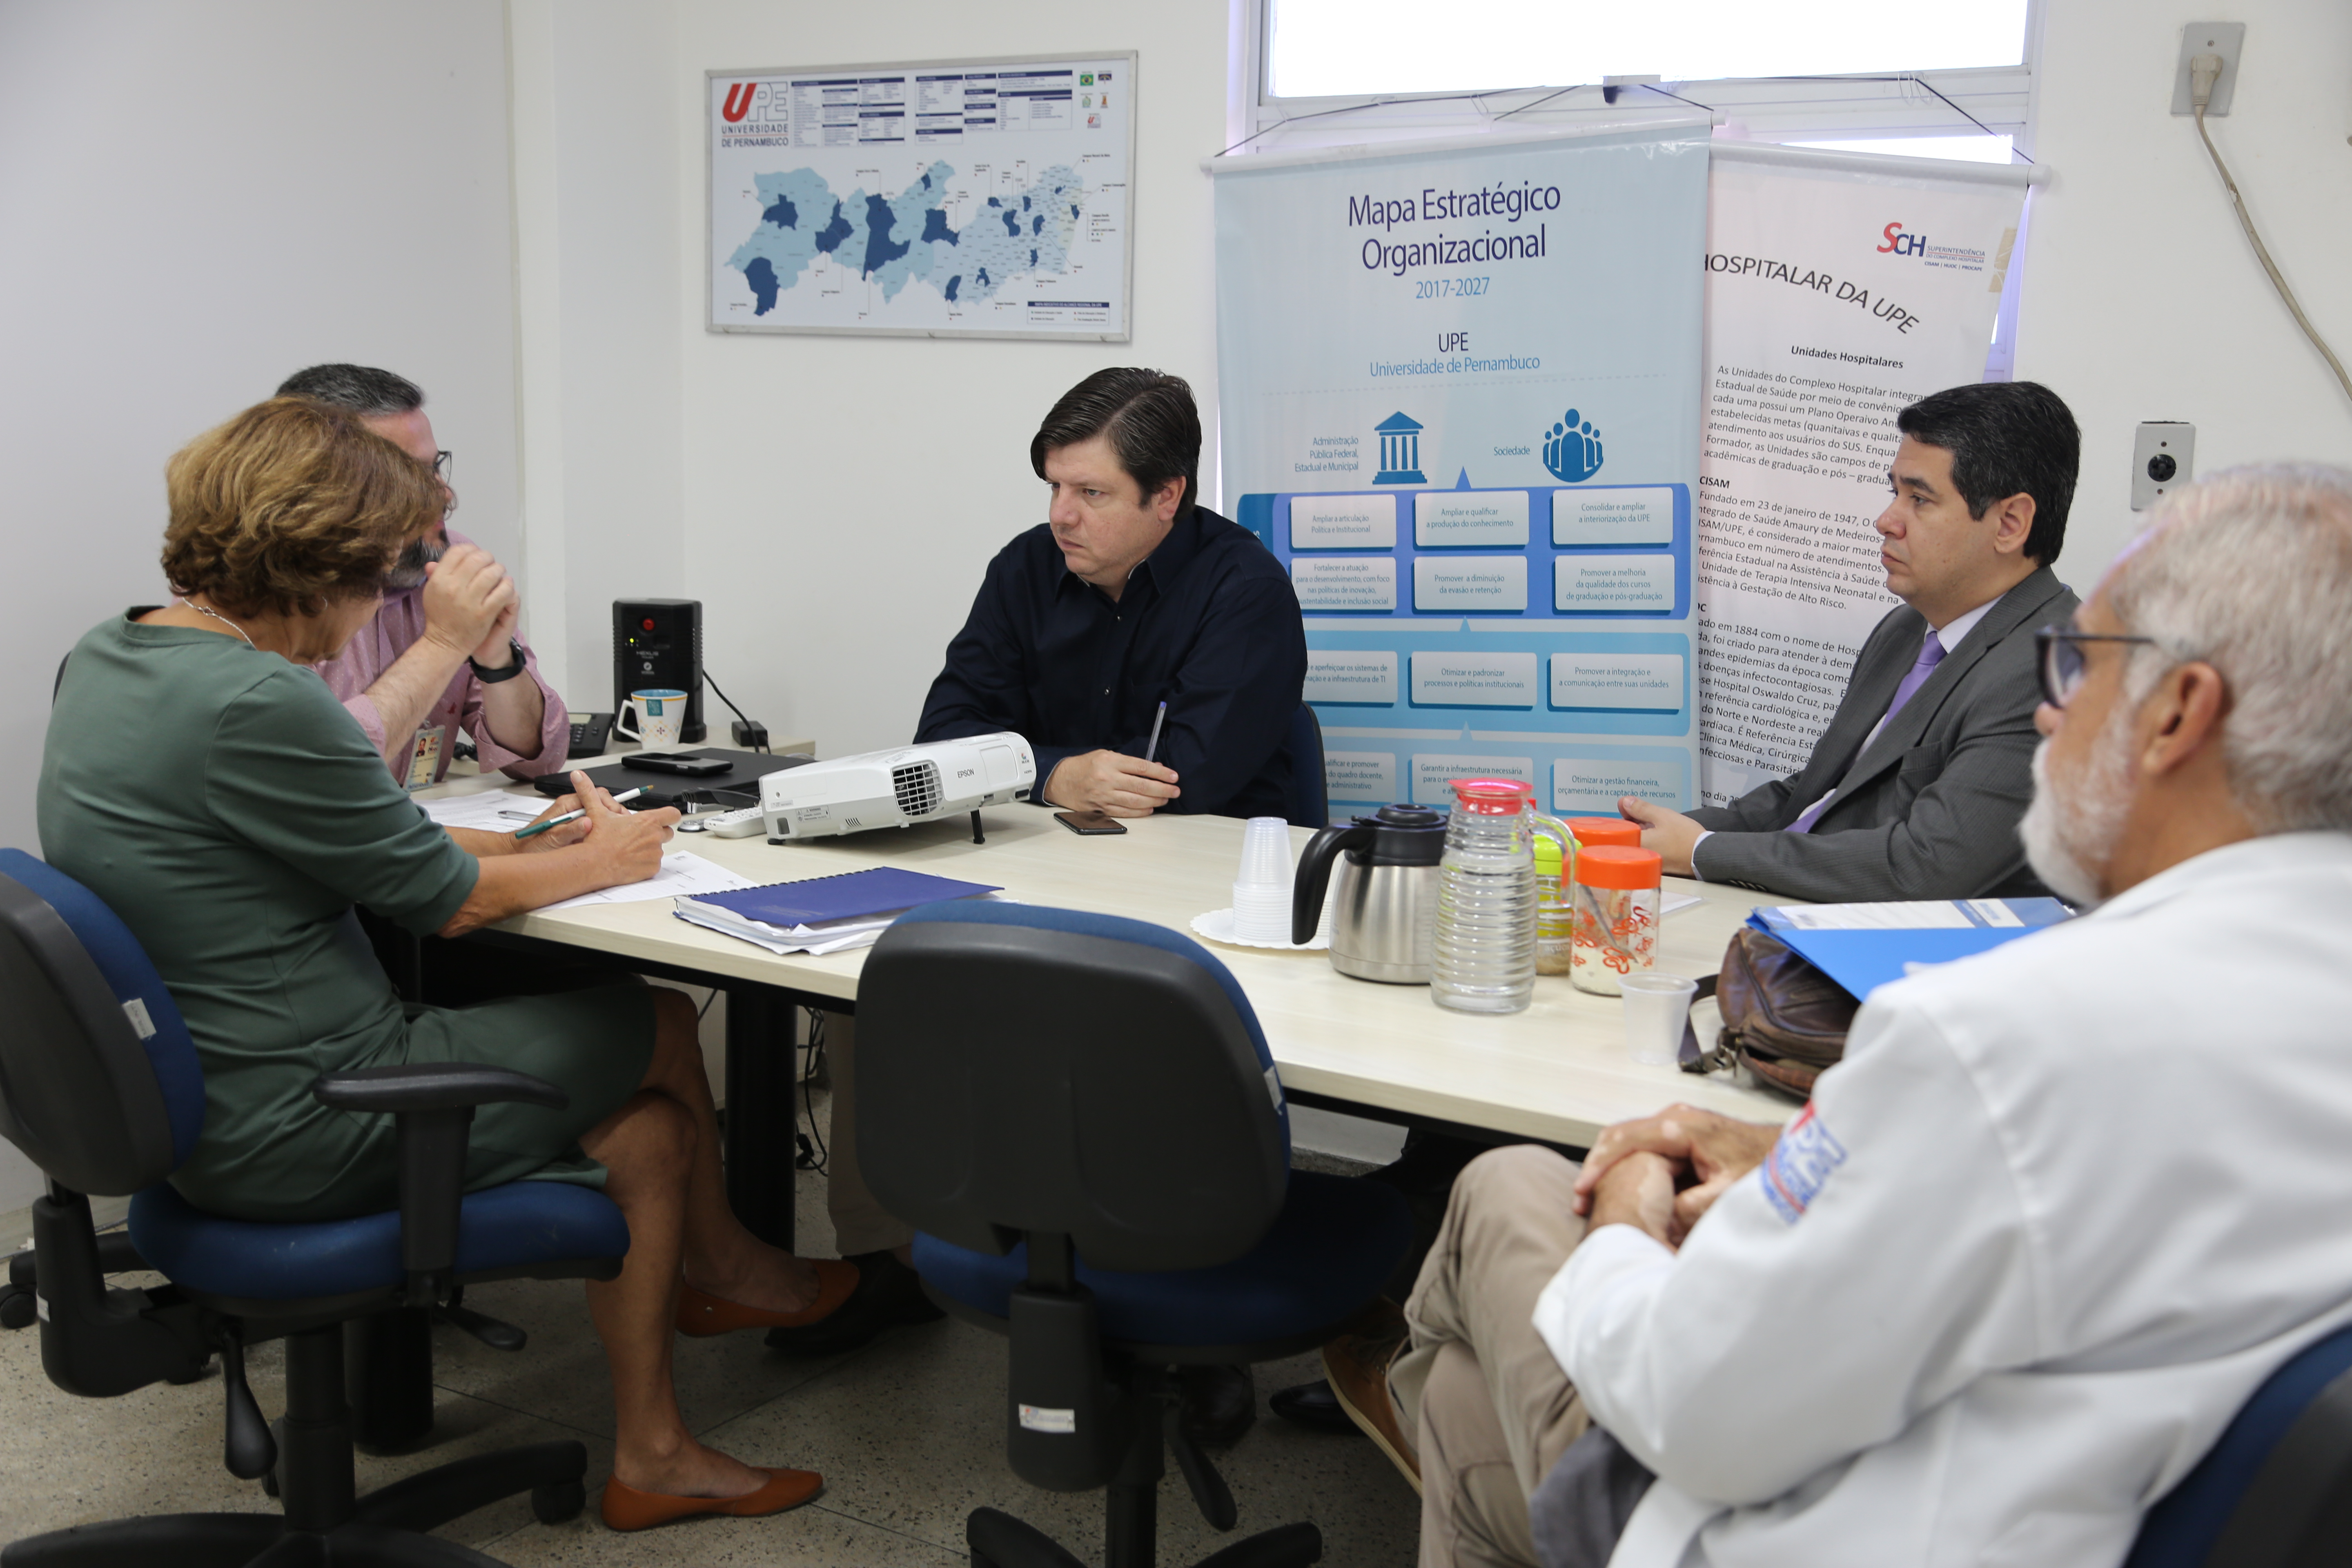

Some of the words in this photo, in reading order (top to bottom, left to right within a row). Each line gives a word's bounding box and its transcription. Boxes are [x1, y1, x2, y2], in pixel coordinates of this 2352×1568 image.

[723, 82, 788, 122] UPE
[722, 124, 788, 134] UNIVERSIDADE
[722, 138, 731, 147] DE
[734, 137, 788, 147] PERNAMBUCO
[1349, 195, 1415, 232] Mapa
[1423, 181, 1560, 222] Estratégico
[1876, 222, 1927, 257] SCH
[1363, 223, 1545, 276] Organizacional
[1927, 246, 1985, 256] SUPERINTENDÊNCIA
[1416, 277, 1490, 299] 2017-2027
[1836, 281, 1868, 309] DA
[1873, 298, 1919, 334] UPE
[1439, 332, 1468, 352] UPE
[1791, 346, 1837, 359] Unidades
[1840, 352, 1903, 368] Hospitalares
[1370, 358, 1444, 376] Universidade
[1447, 357, 1461, 373] de
[1465, 354, 1540, 372] Pernambuco
[1718, 365, 1728, 374] As
[1732, 367, 1772, 381] Unidades
[1775, 374, 1787, 383] do
[1790, 376, 1835, 390] Complexo
[1838, 382, 1887, 396] Hospitalar
[1716, 379, 1755, 392] Estadual
[1757, 385, 1767, 394] de
[1770, 387, 1797, 399] Saúde
[1800, 393, 1816, 402] por
[1819, 396, 1842, 405] meio
[1844, 398, 1855, 407] de
[1713, 394, 1734, 404] cada
[1737, 399, 1757, 407] uma
[1760, 402, 1787, 412] possui
[1790, 406, 1804, 414] um
[1808, 407, 1833, 418] Plano
[1711, 409, 1771, 423] estabelecidas
[1774, 419, 1801, 428] metas
[1313, 436, 1359, 447] Administração
[1310, 450, 1333, 459] Pública
[1334, 448, 1359, 458] Federal,
[1494, 445, 1530, 456] Sociedade
[1295, 462, 1321, 472] Estadual
[1328, 461, 1359, 472] Municipal
[1700, 476, 1729, 488] CISAM
[1441, 508, 1464, 517] Ampliar
[1470, 507, 1498, 517] qualificar
[1581, 503, 1615, 511] Consolidar
[1621, 502, 1645, 512] ampliar
[1699, 491, 1737, 504] Fundado
[1758, 501, 1769, 510] 23
[1771, 503, 1782, 512] de
[1784, 505, 1816, 518] janeiro
[1819, 511, 1831, 520] de
[1834, 513, 1859, 526] 1947,
[1862, 518, 1870, 526] O
[1313, 514, 1333, 523] Ampliar
[1339, 514, 1369, 523] articulação
[1584, 514, 1626, 523] interiorização
[1628, 514, 1636, 522] da
[1336, 525, 1370, 533] Institucional
[1431, 520, 1460, 529] produção
[1618, 568, 1646, 576] melhoria
[1471, 574, 1504, 584] diminuição
[1576, 580, 1584, 588] da
[1585, 579, 1616, 590] qualidade
[1617, 579, 1629, 588] dos
[1702, 561, 1737, 575] Unidade
[1740, 568, 1752, 577] de
[1755, 571, 1787, 584] Terapia
[1790, 577, 1830, 592] Intensiva
[1834, 585, 1876, 600] Neonatal
[1475, 586, 1501, 595] retenção
[1732, 581, 1737, 589] à
[1740, 583, 1782, 597] Gestação
[1785, 590, 1796, 600] de
[1799, 593, 1817, 604] Alto
[1820, 597, 1846, 609] Risco.
[1576, 592, 1608, 601] graduação
[1615, 592, 1662, 601] pós-graduação
[1473, 668, 1504, 677] padronizar
[1575, 667, 1605, 675] Promover
[1612, 668, 1645, 677] integração
[1459, 679, 1483, 688] políticas
[1564, 679, 1605, 688] comunicação
[1640, 679, 1668, 688] unidades
[1704, 662, 1740, 677] doenças
[1743, 670, 1833, 695] infectocontagiosas.
[1714, 678, 1750, 693] Hospital
[1753, 687, 1794, 702] Oswaldo
[1797, 695, 1820, 708] Cruz,
[1702, 704, 1713, 713] do
[1716, 707, 1741, 720] Norte
[1752, 715, 1795, 731] Nordeste
[1730, 739, 1764, 755] Médica,
[957, 768, 975, 778] EPSON
[1572, 775, 1598, 784] Otimizar
[1627, 777, 1659, 787] financeira,
[1558, 787, 1598, 795] orçamentária
[1639, 789, 1648, 797] de
